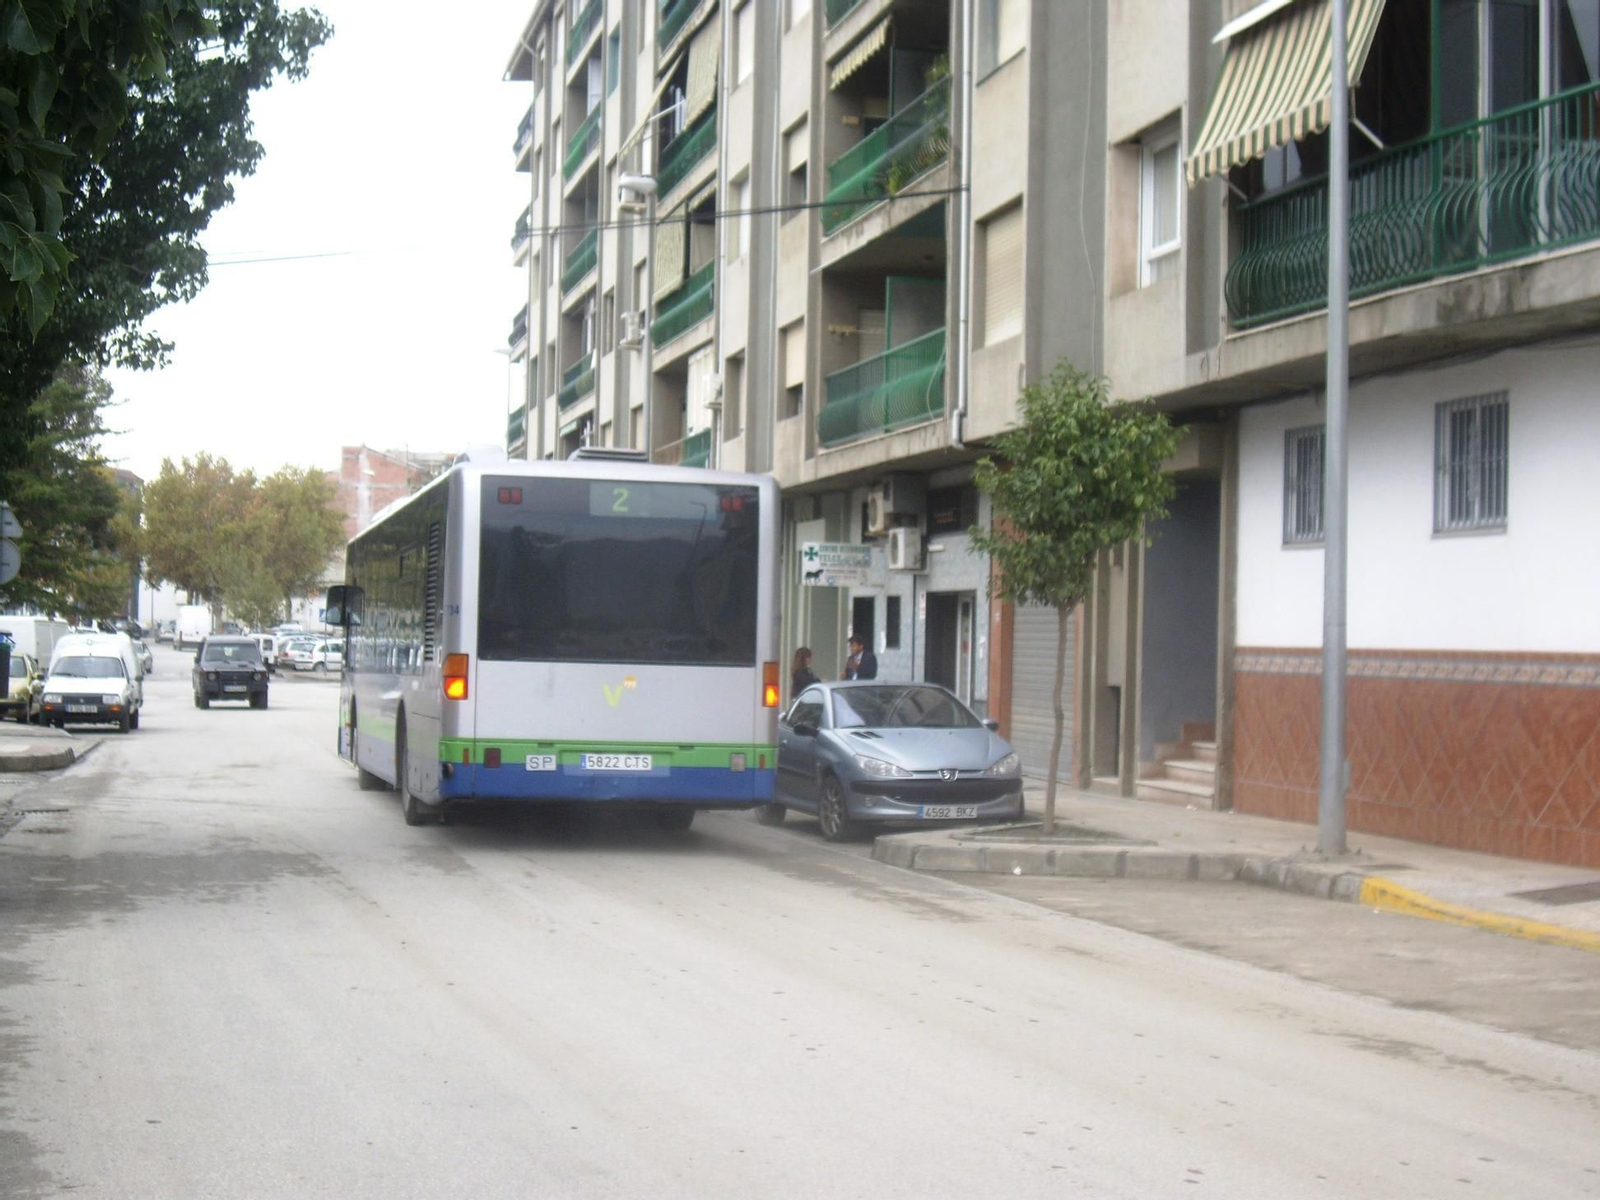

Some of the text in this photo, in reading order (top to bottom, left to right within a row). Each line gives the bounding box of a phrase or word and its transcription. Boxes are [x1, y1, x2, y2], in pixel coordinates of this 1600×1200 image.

[612, 487, 629, 513] 2
[529, 756, 553, 769] SP
[587, 756, 650, 769] 5822 CTS
[925, 807, 975, 818] 4592 BKZ
